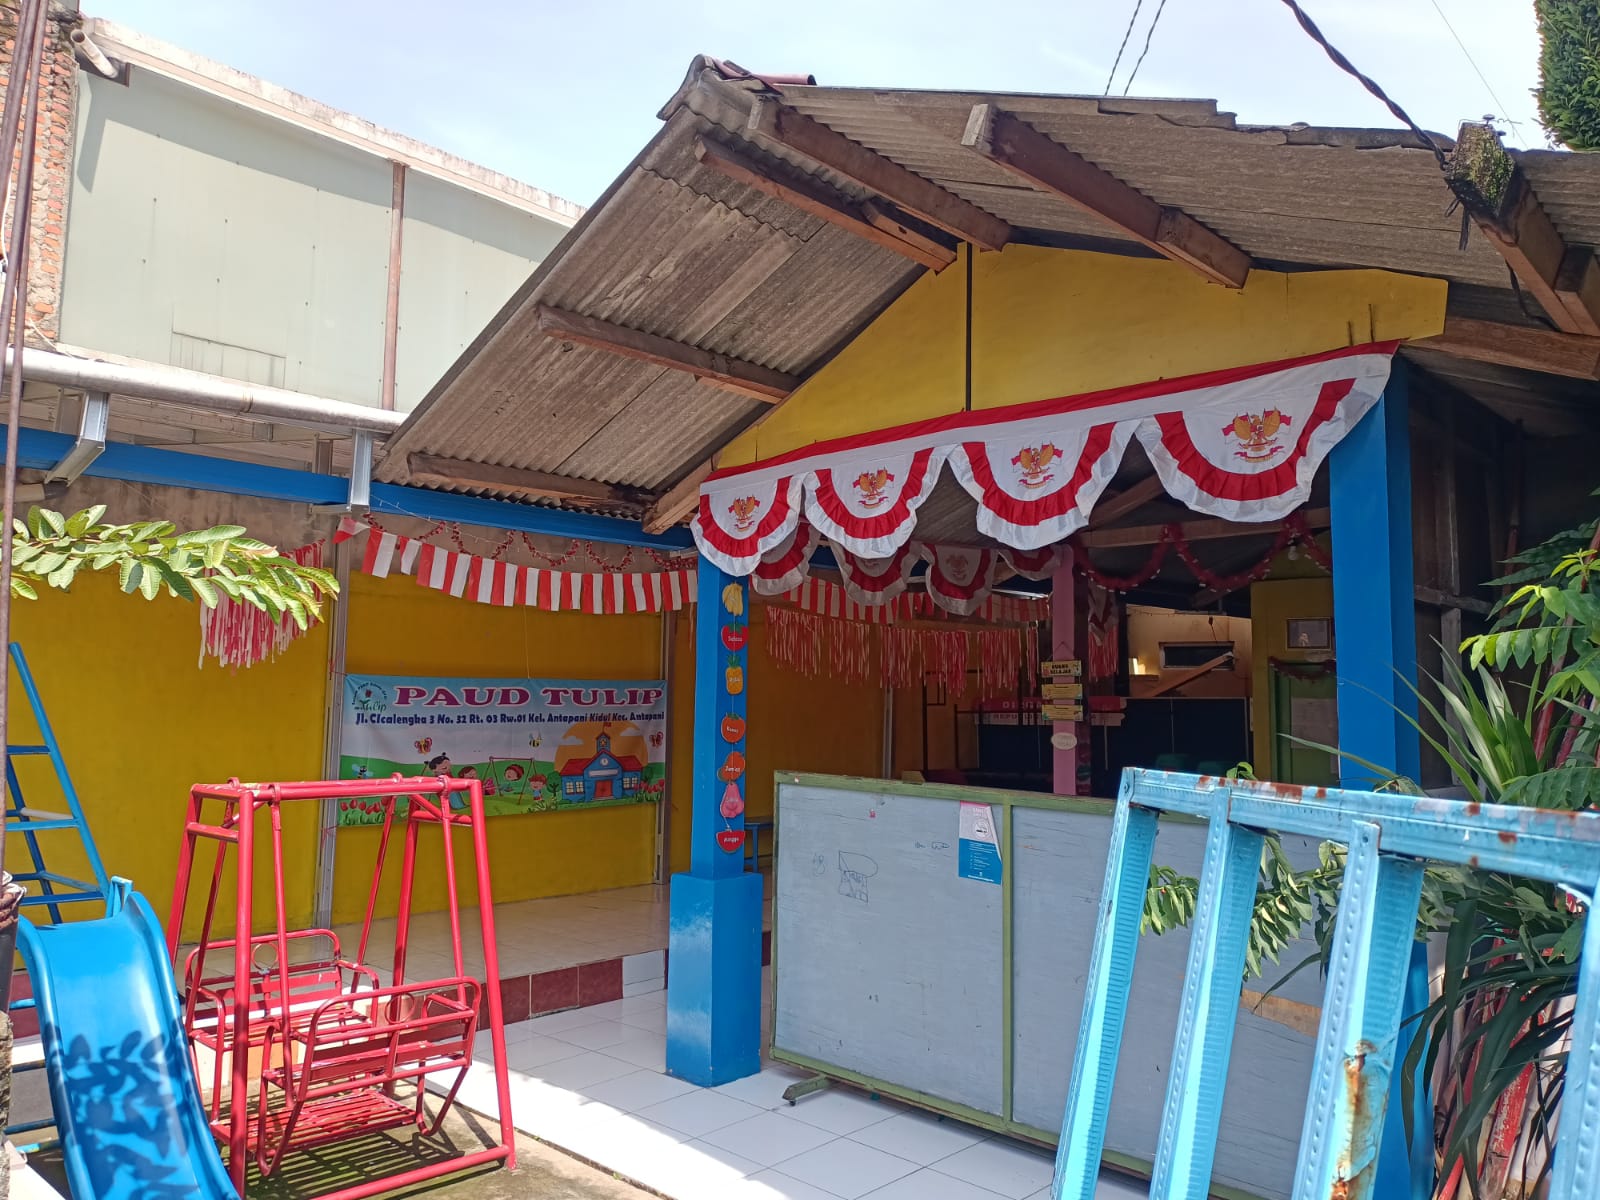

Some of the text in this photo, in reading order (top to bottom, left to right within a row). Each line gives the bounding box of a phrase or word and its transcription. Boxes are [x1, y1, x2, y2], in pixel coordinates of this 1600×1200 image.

[394, 687, 530, 707] PAUD
[541, 688, 663, 707] TULIP
[355, 713, 368, 725] Jl.
[429, 715, 435, 724] 3
[437, 714, 454, 724] No.
[469, 713, 484, 724] Rt.
[486, 714, 498, 723] 03
[528, 713, 545, 723] Kel.
[547, 713, 588, 724] Antapani
[589, 712, 611, 722] Kidul
[612, 712, 628, 722] Kec.
[630, 711, 665, 722] Antapani
